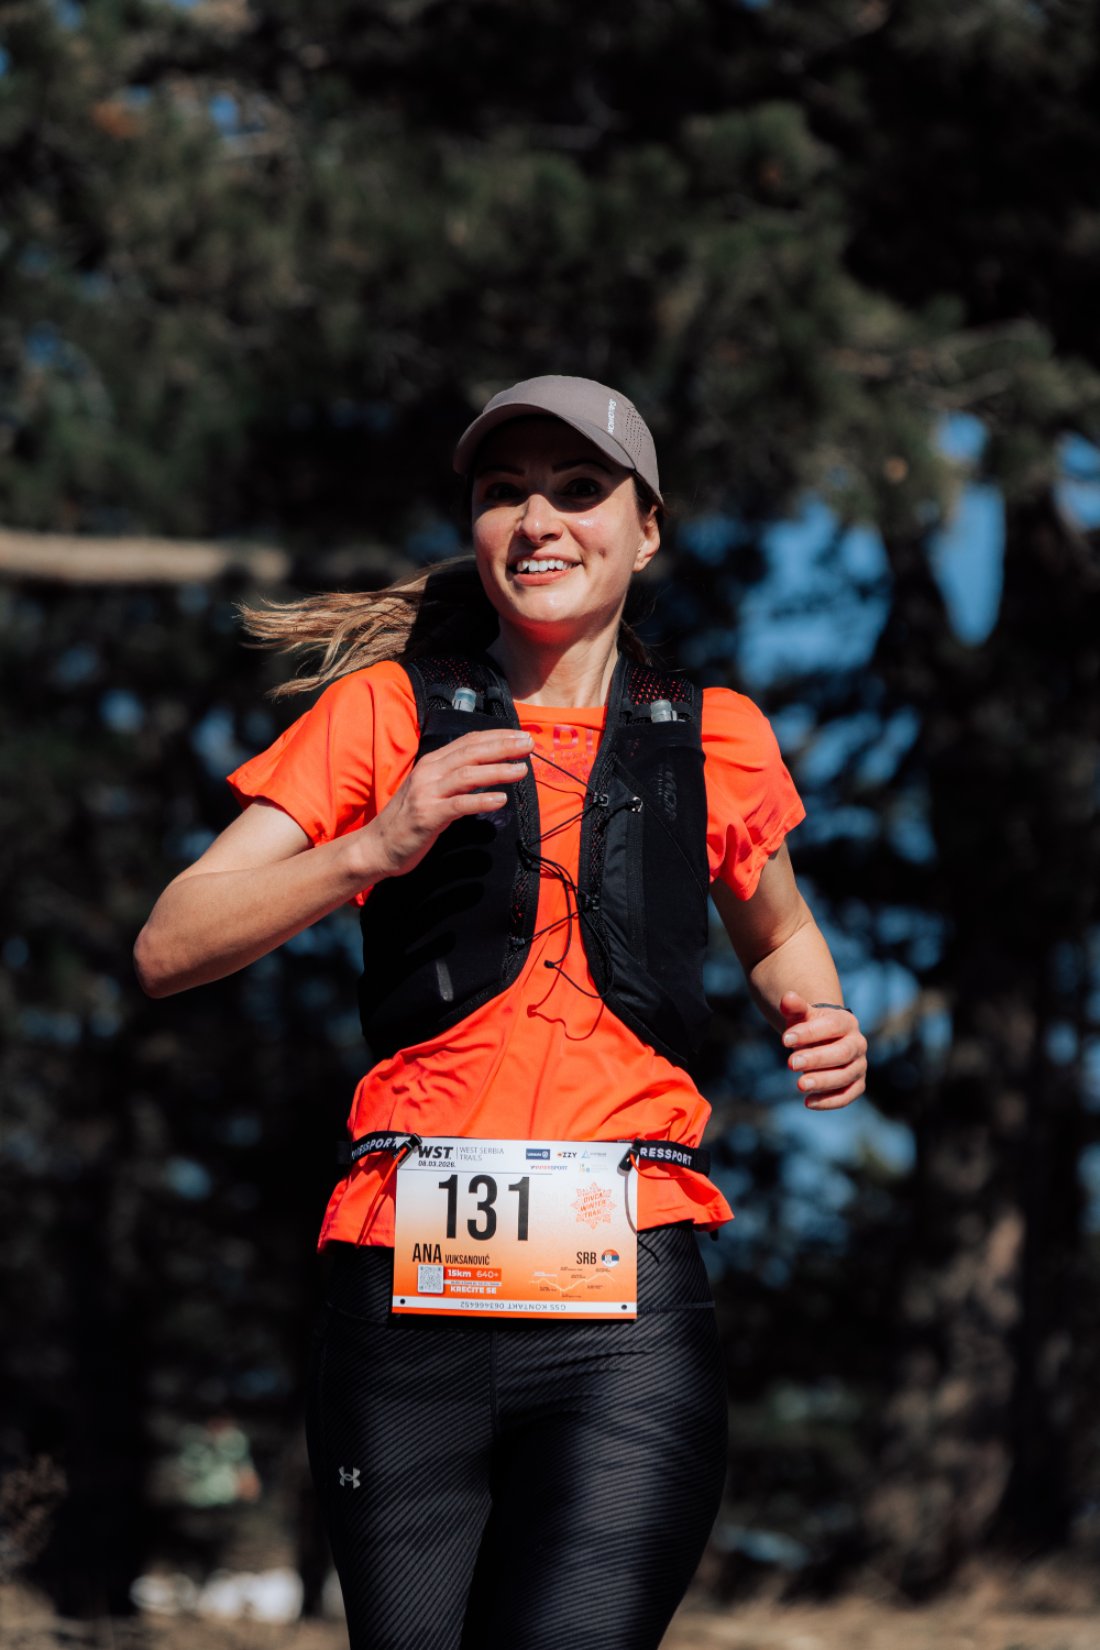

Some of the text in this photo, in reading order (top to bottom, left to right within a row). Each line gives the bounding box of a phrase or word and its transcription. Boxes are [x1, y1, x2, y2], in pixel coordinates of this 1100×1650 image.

[418, 1146, 454, 1159] WST
[439, 1174, 530, 1241] 131
[412, 1243, 490, 1265] ANA VUKSANOVIĆ
[576, 1251, 597, 1265] SRB
[508, 1302, 548, 1311] KONTAKT
